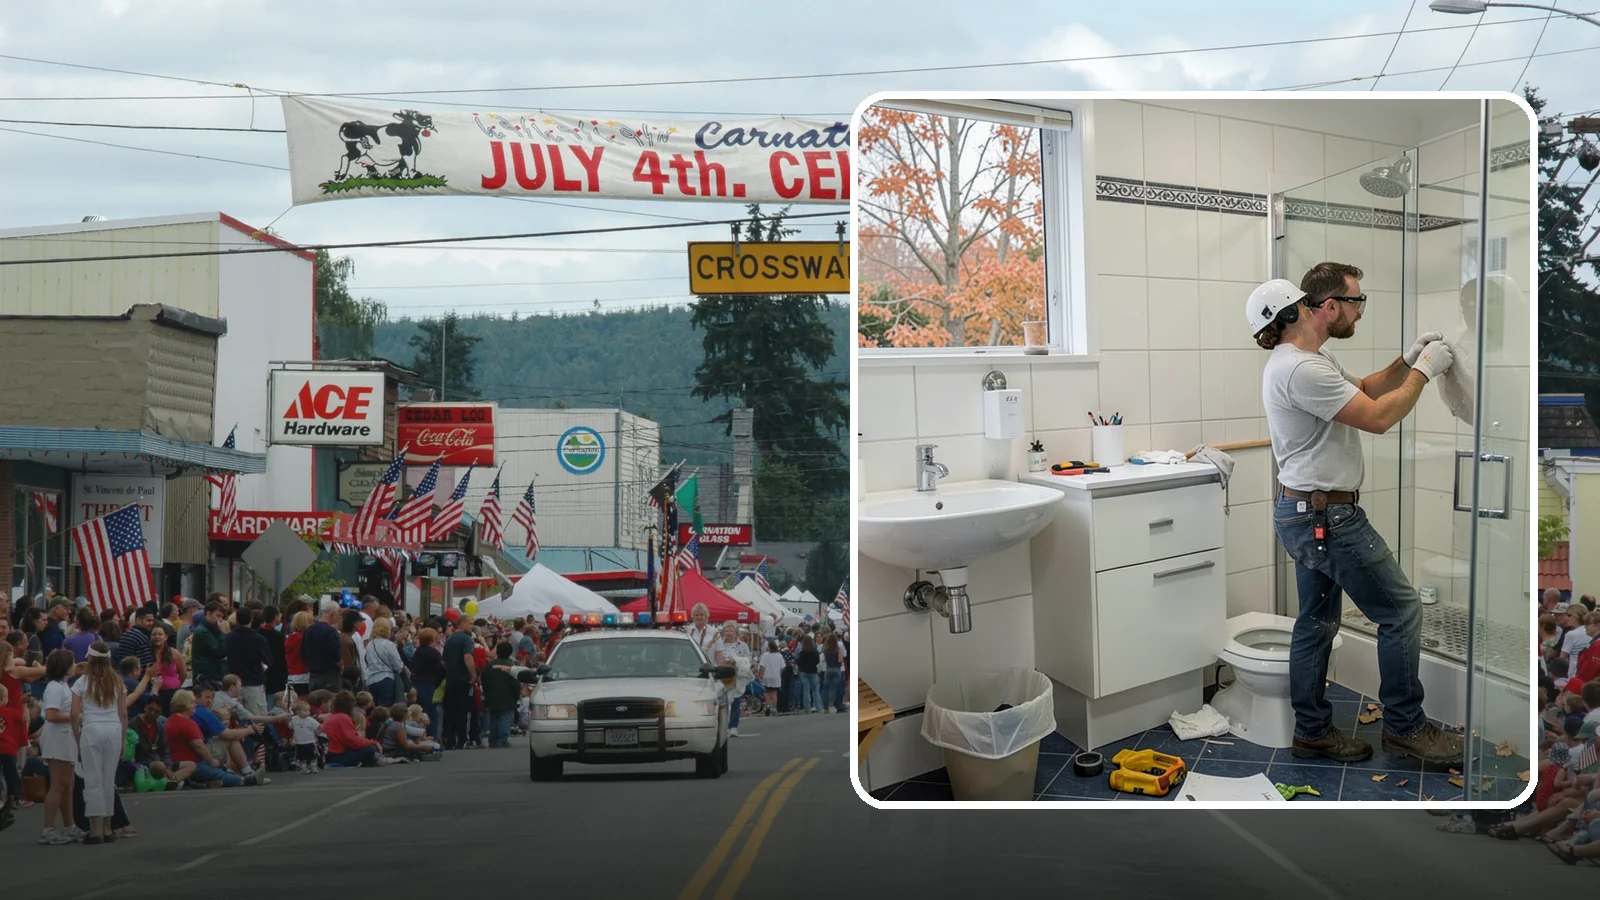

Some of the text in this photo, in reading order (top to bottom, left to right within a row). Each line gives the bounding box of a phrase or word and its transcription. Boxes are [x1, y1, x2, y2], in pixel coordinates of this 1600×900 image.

[481, 140, 604, 194] JULY
[632, 149, 746, 198] 4th.
[282, 380, 374, 420] ACE
[405, 409, 453, 421] CEDAR
[283, 421, 371, 437] Hardware
[416, 428, 477, 447] Coca-Cola
[354, 467, 381, 479] Simpl
[83, 484, 155, 496] St. Vincent de Paul
[81, 502, 154, 522] THT
[212, 515, 332, 536] HARDARE
[687, 526, 741, 535] CRNATION
[698, 535, 730, 543] GLASS
